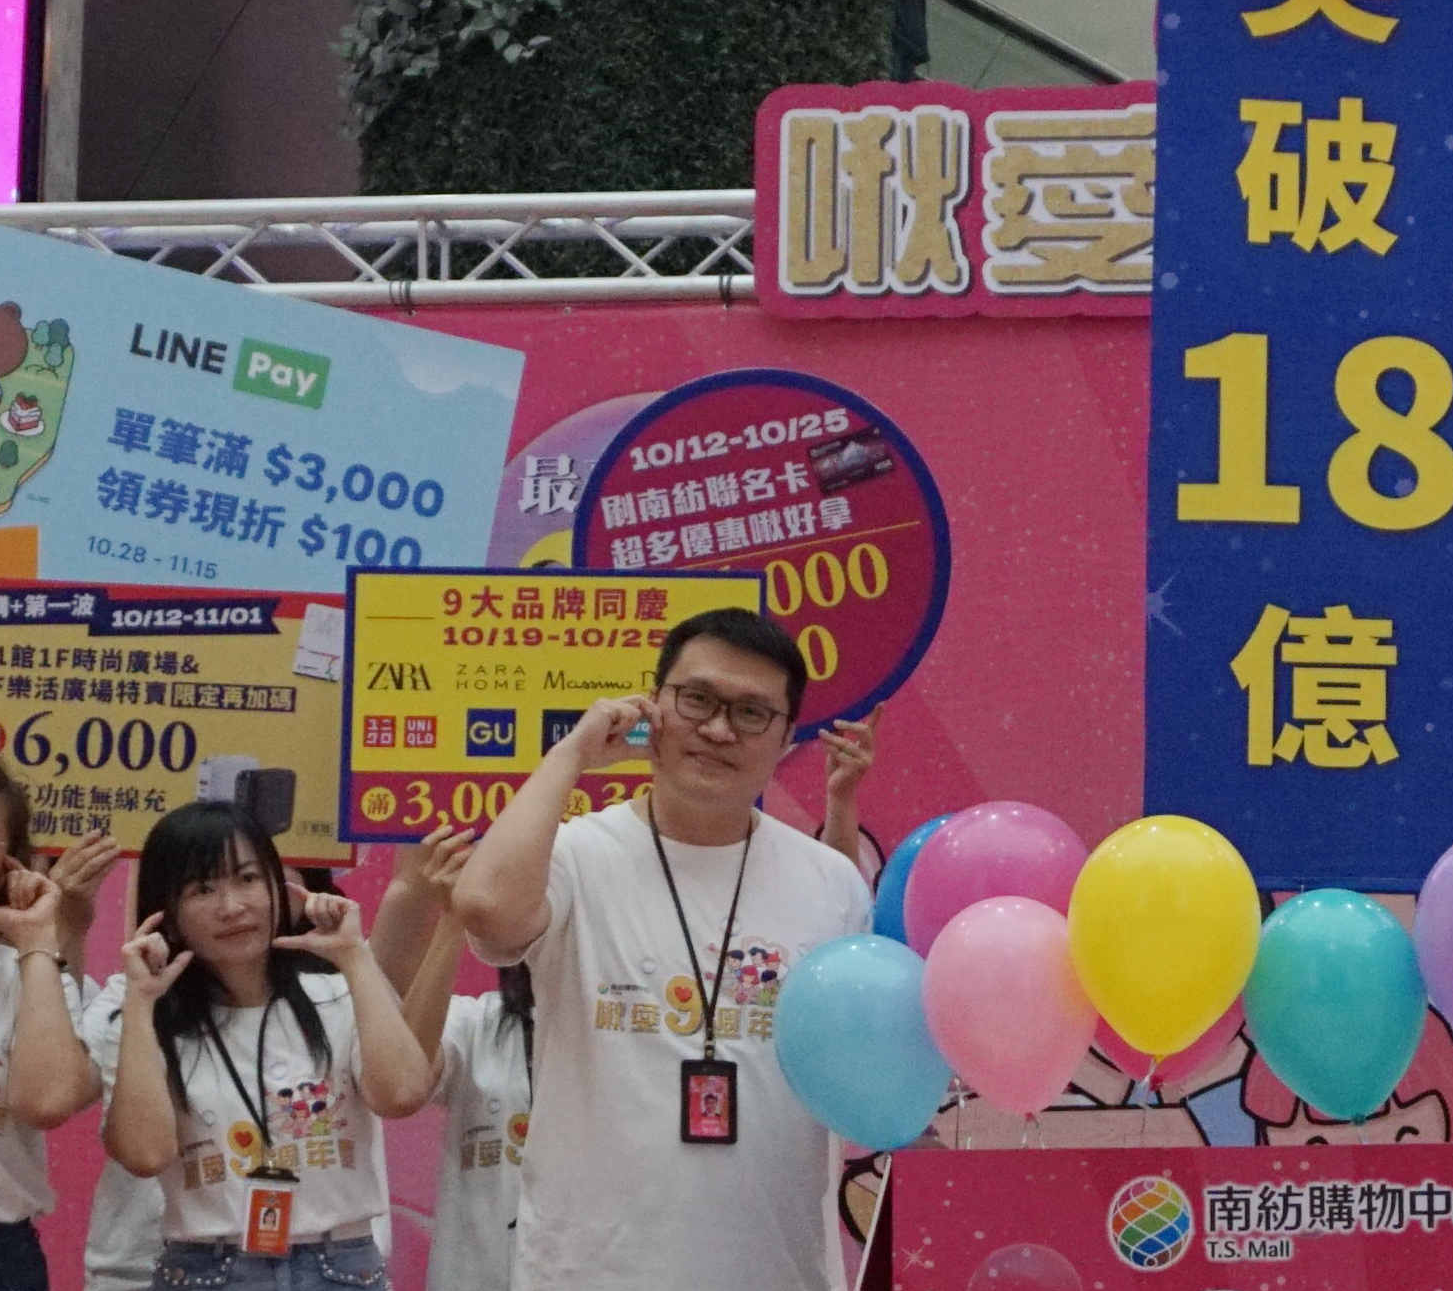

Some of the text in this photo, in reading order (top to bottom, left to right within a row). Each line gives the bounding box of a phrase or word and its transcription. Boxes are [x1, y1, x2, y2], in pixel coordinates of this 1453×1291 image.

[130, 323, 317, 398] LINE Pay
[107, 408, 444, 517] 單筆滿 $3,000
[631, 409, 848, 472] 10/12-10/25
[88, 535, 146, 565] 10.28
[169, 554, 219, 580] 11.15
[298, 514, 422, 568] $100
[112, 607, 263, 628] 10/12-11/01
[442, 585, 669, 621] 9大品牌同慶
[442, 626, 666, 648] 10/19-10/25
[367, 661, 431, 691] ZARA
[13, 711, 196, 777] 6,000
[470, 720, 515, 745] GU
[403, 780, 514, 827] 3,00
[1207, 1240, 1290, 1259] T.S. Mall
